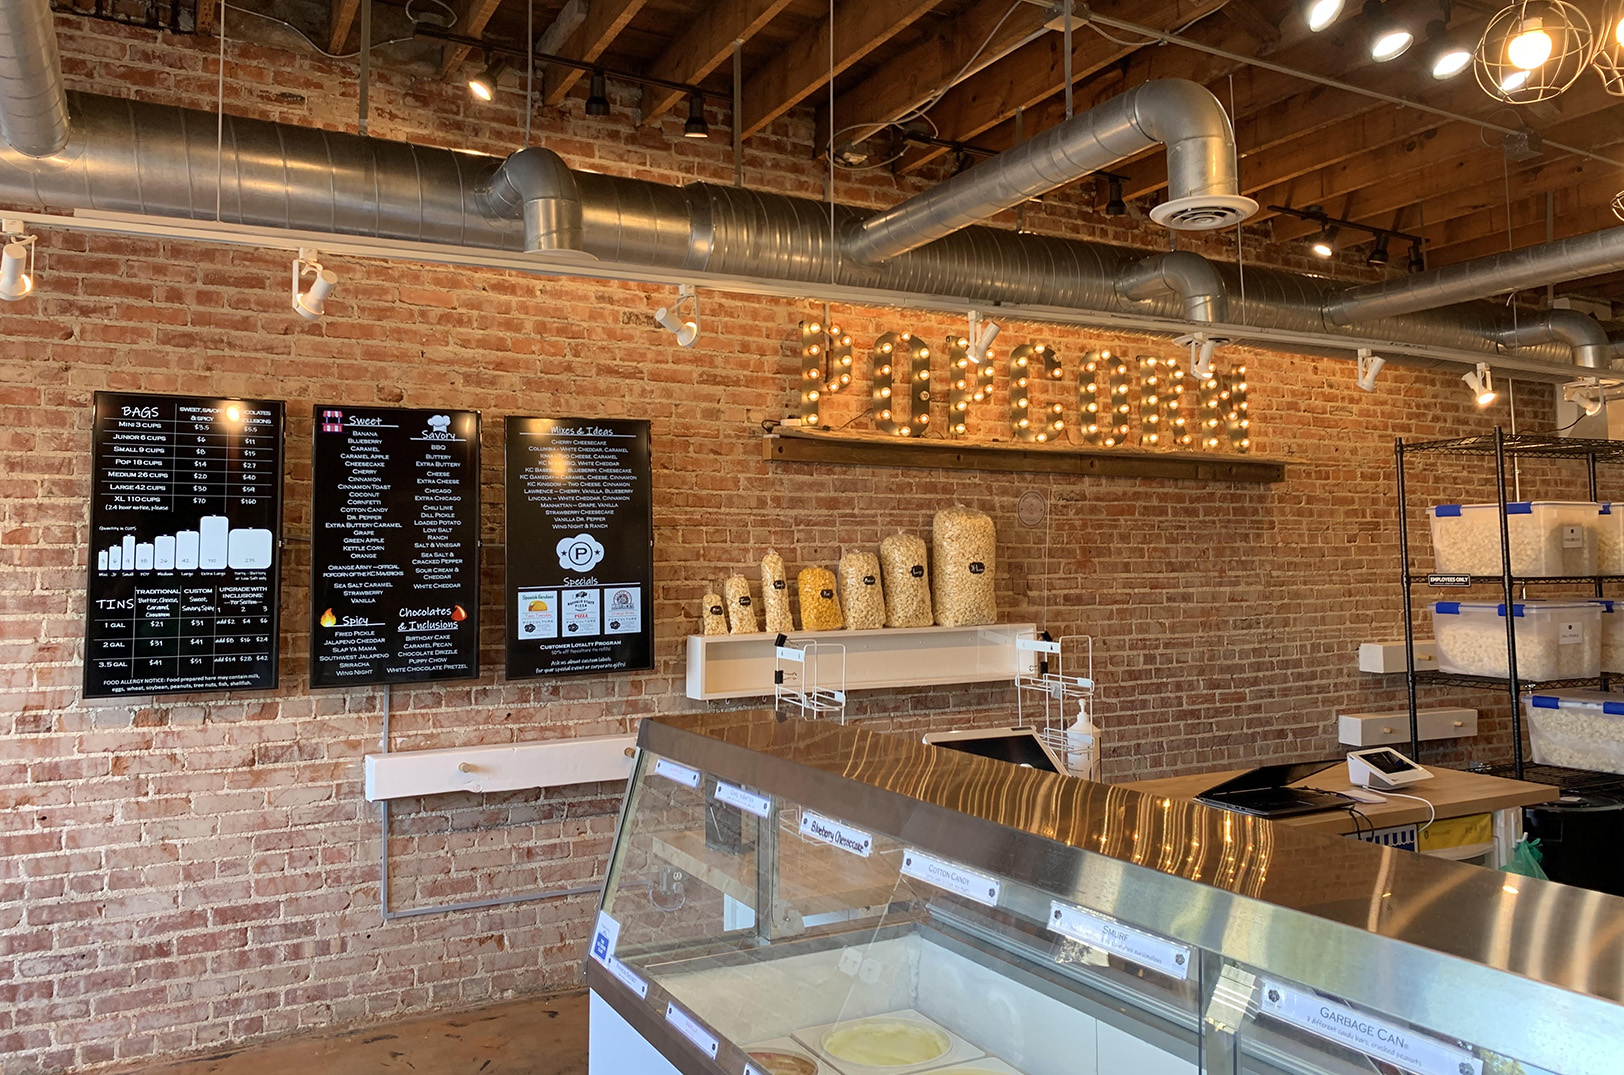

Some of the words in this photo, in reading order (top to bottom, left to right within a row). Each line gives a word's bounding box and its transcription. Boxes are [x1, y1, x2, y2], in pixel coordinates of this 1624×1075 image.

[801, 320, 1249, 452] POPCORN
[122, 406, 159, 418] BAGS
[349, 415, 382, 425] Sweet
[422, 431, 455, 440] Savory
[551, 427, 574, 435] Mixes
[577, 427, 584, 435] &
[586, 427, 613, 435] Ideas
[576, 548, 586, 559] P
[564, 577, 598, 586] Specials
[96, 599, 134, 609] TINS
[399, 607, 451, 617] Chocolates
[342, 616, 368, 626] Spicy
[398, 622, 407, 630] &
[409, 620, 458, 630] Inclusions
[811, 820, 835, 842] Blueberry
[835, 831, 864, 853] Cheesecake
[928, 864, 950, 878] COTTON
[951, 872, 970, 885] CANDY
[1102, 926, 1129, 941] SMURF
[1319, 1006, 1374, 1037] GARBAGE
